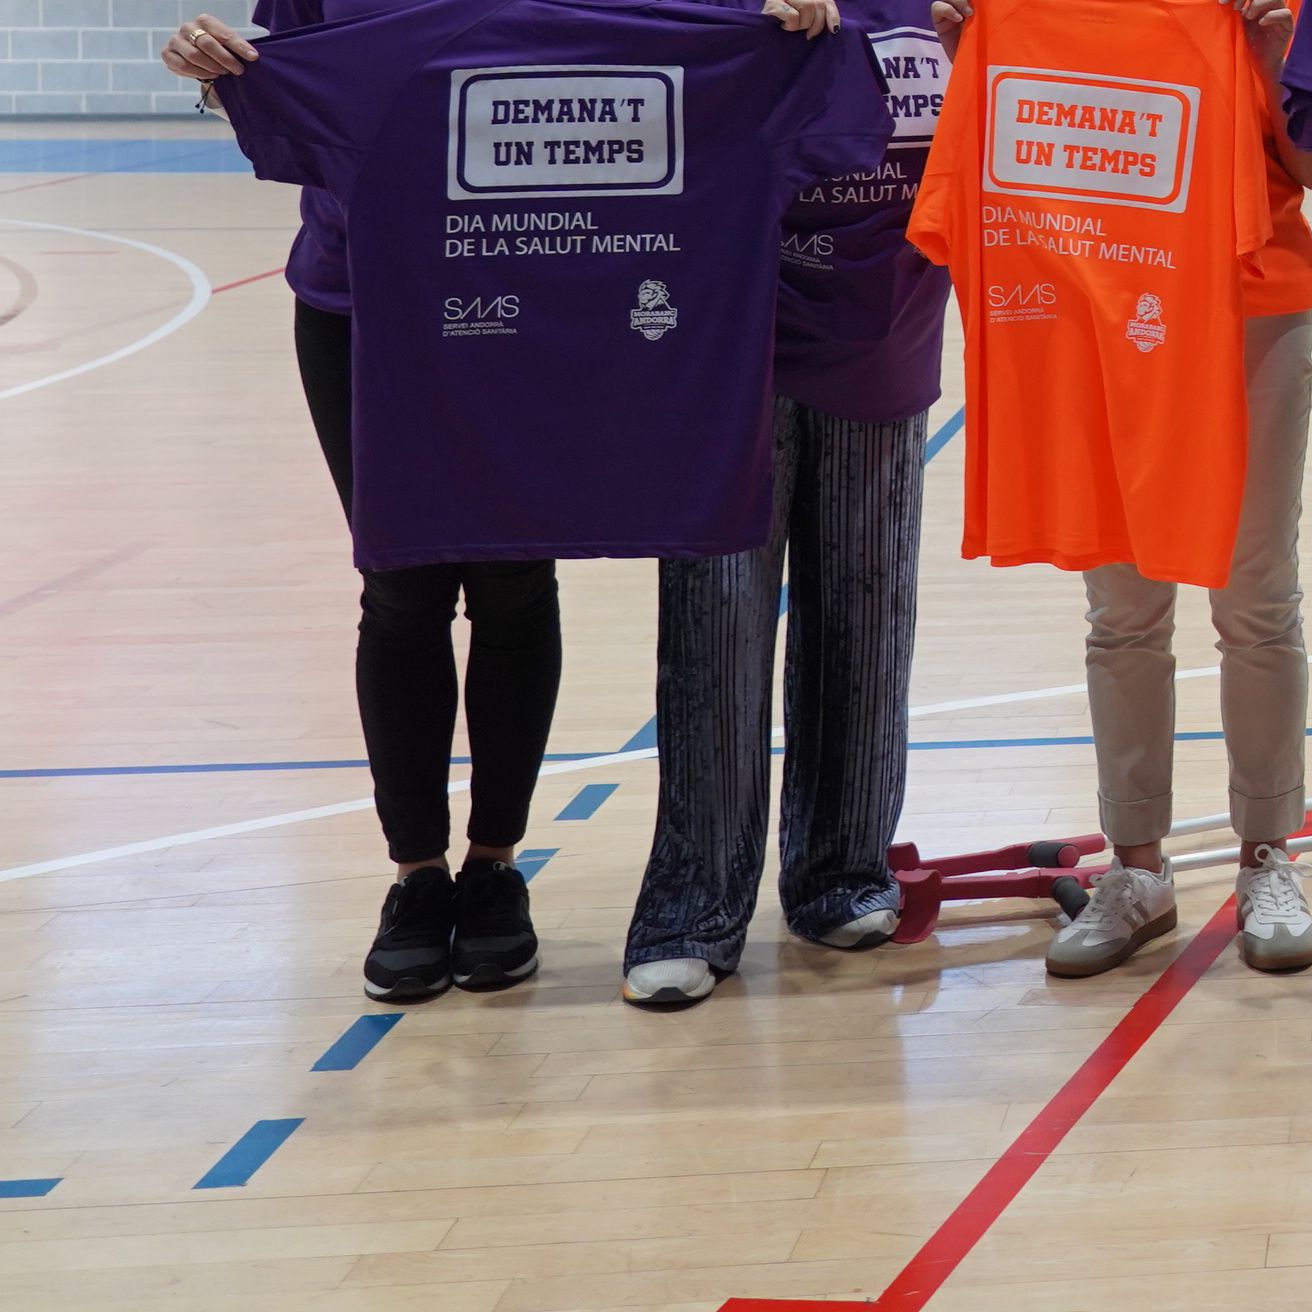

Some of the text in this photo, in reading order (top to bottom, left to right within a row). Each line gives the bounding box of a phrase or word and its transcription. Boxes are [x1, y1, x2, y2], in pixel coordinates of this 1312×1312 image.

[491, 98, 645, 125] DEMANA'T
[1016, 99, 1163, 137] DEMANA'T
[493, 140, 644, 166] UN TEMPS
[1015, 140, 1157, 177] UN TEMPS
[832, 185, 896, 203] SALUT
[446, 211, 598, 233] DIA MUNDIAL
[983, 206, 1107, 236] DIA MUNDIAL
[445, 233, 680, 257] DE LA SALUT MENTAL
[984, 229, 1176, 269] DE LA SALUT MENTAL
